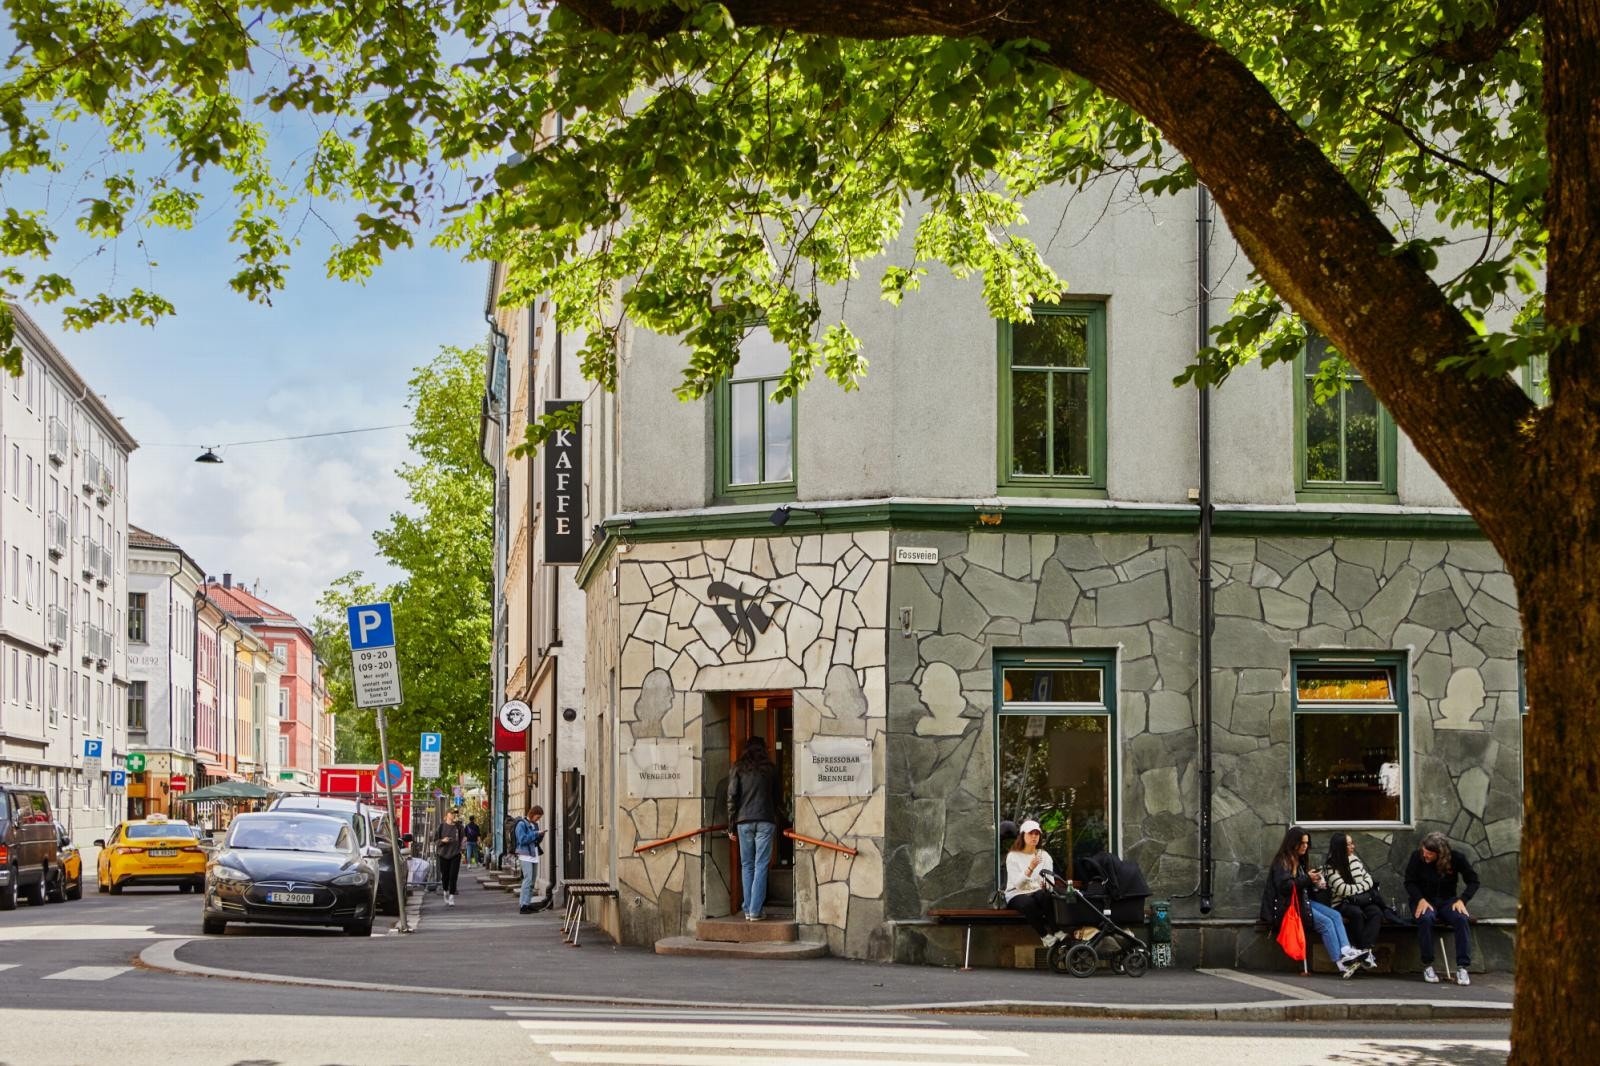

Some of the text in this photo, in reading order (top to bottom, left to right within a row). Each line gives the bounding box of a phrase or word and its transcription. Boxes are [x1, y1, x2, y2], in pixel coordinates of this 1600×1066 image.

[555, 429, 572, 535] KAFFE
[898, 549, 937, 560] Fossveien
[358, 610, 382, 643] P
[88, 742, 98, 755] P
[425, 736, 437, 750] P
[114, 773, 123, 784] P
[286, 894, 311, 902] 29000
